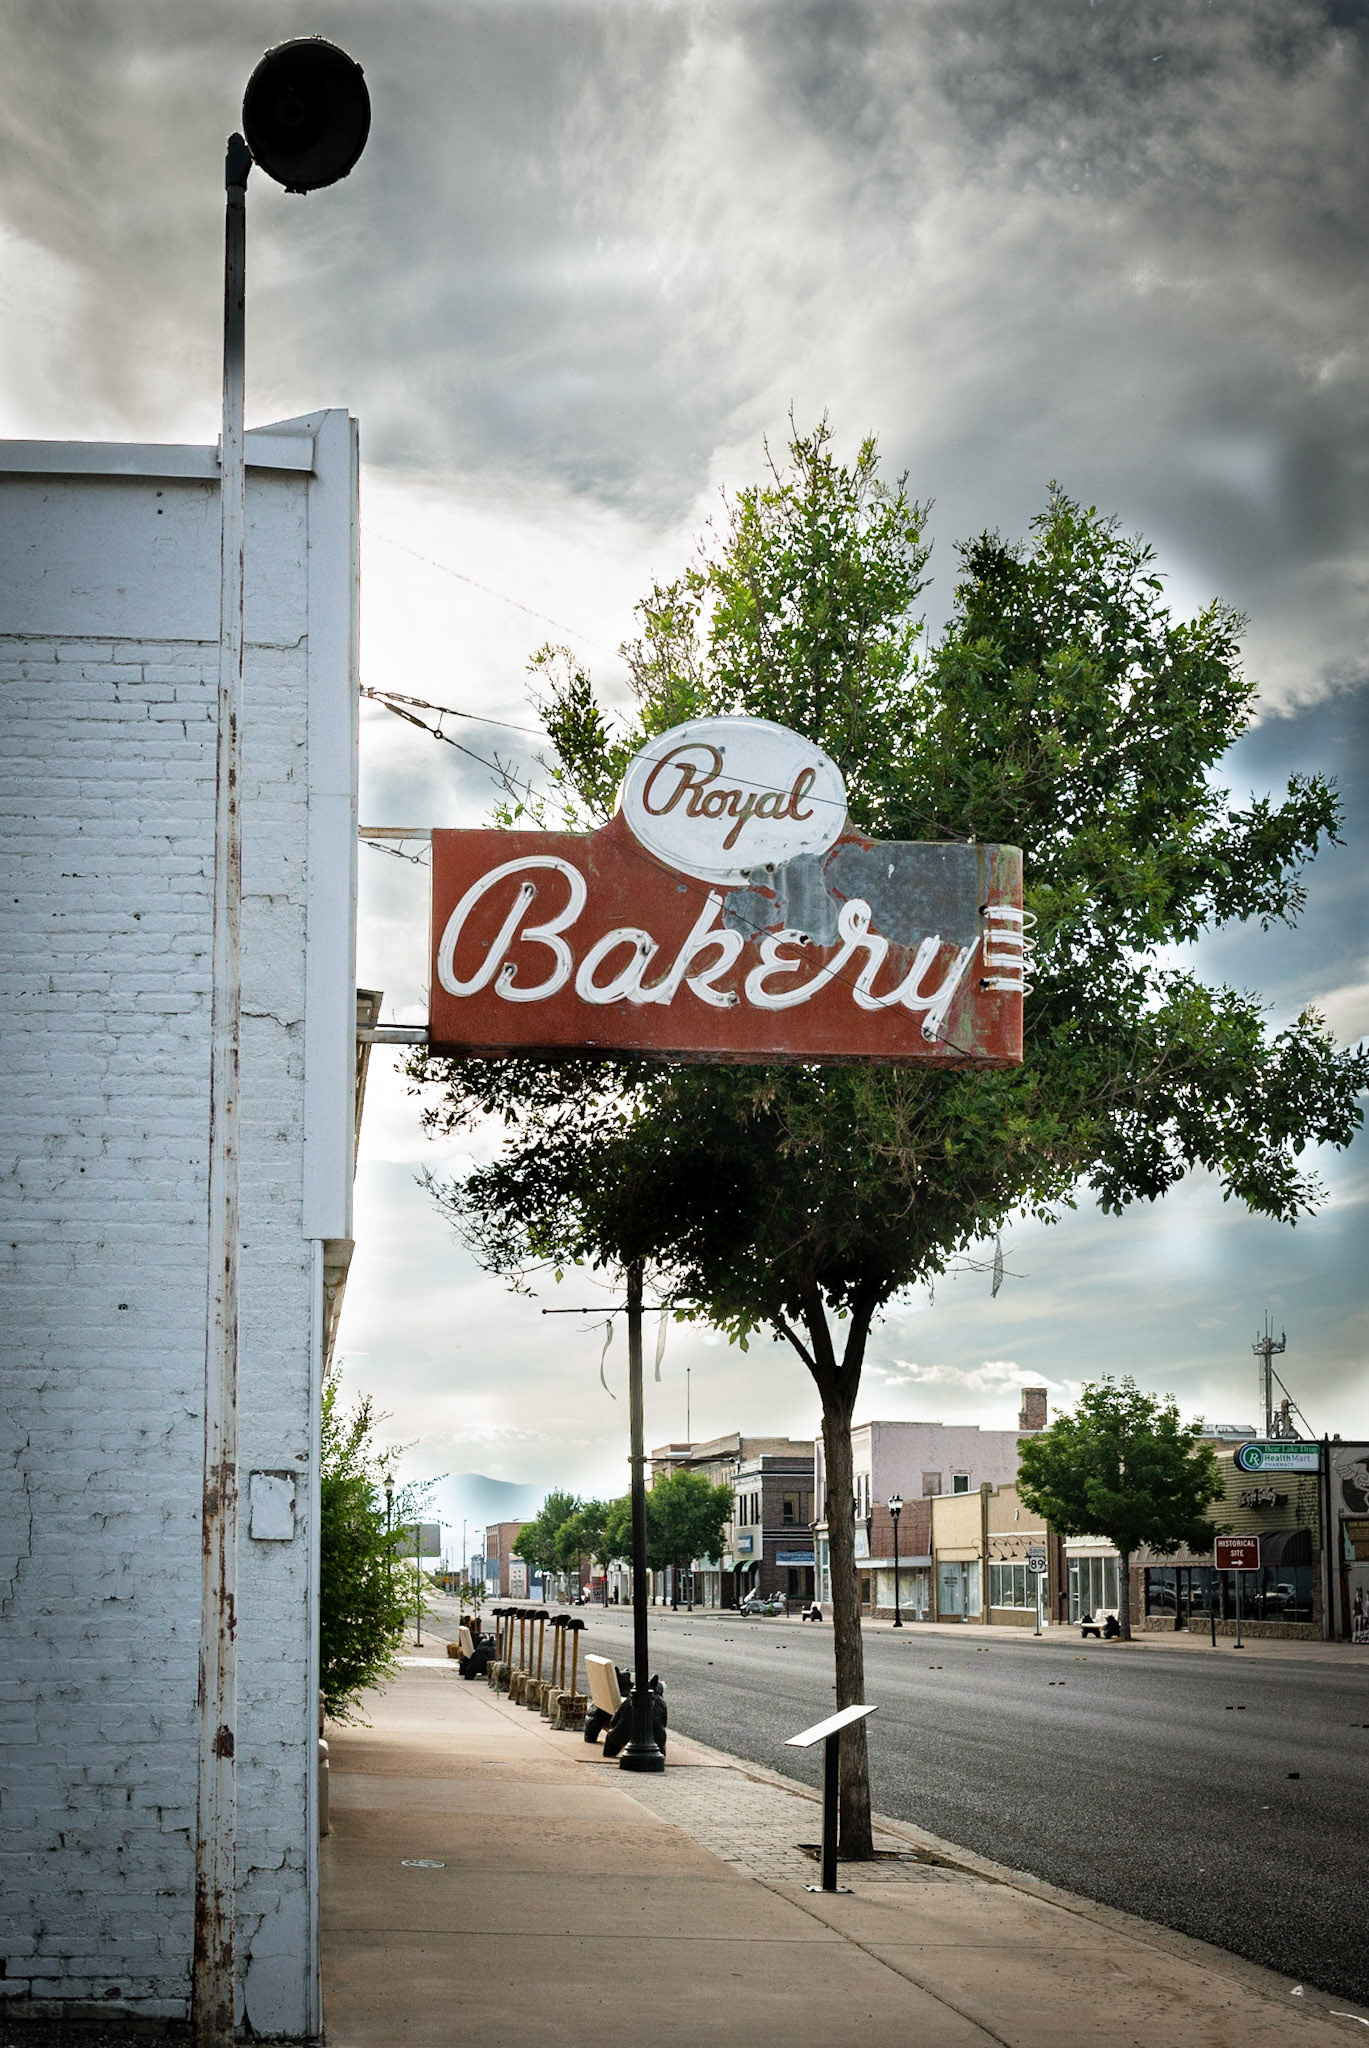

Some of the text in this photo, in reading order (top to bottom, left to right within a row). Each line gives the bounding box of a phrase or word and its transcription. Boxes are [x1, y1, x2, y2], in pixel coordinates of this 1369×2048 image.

[642, 743, 817, 850] Royal
[437, 855, 981, 1043] Bakery
[1300, 1445, 1318, 1453] Drug
[1031, 1559, 1044, 1570] 89
